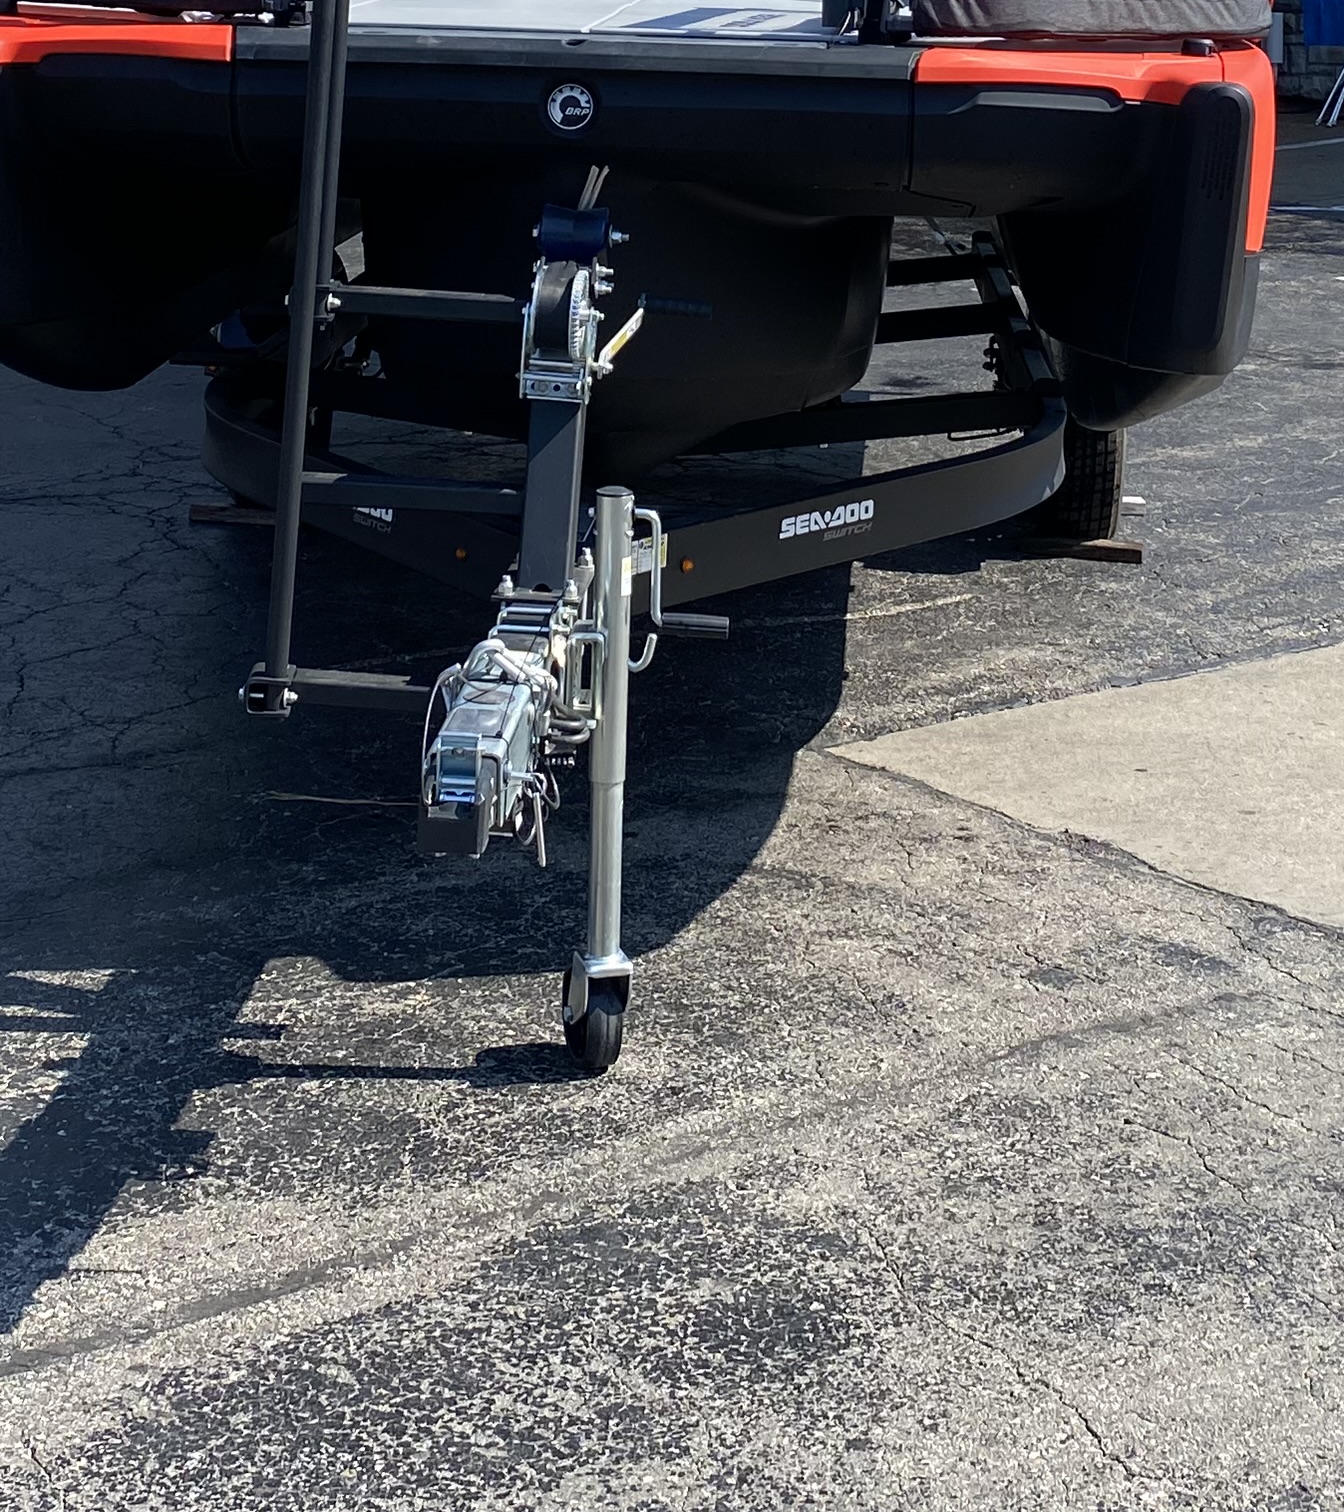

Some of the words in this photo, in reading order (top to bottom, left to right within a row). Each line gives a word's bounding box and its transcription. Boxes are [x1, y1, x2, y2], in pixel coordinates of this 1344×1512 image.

[565, 106, 590, 116] BRP
[353, 513, 392, 534] SWITCH
[822, 522, 873, 541] SWITCH
